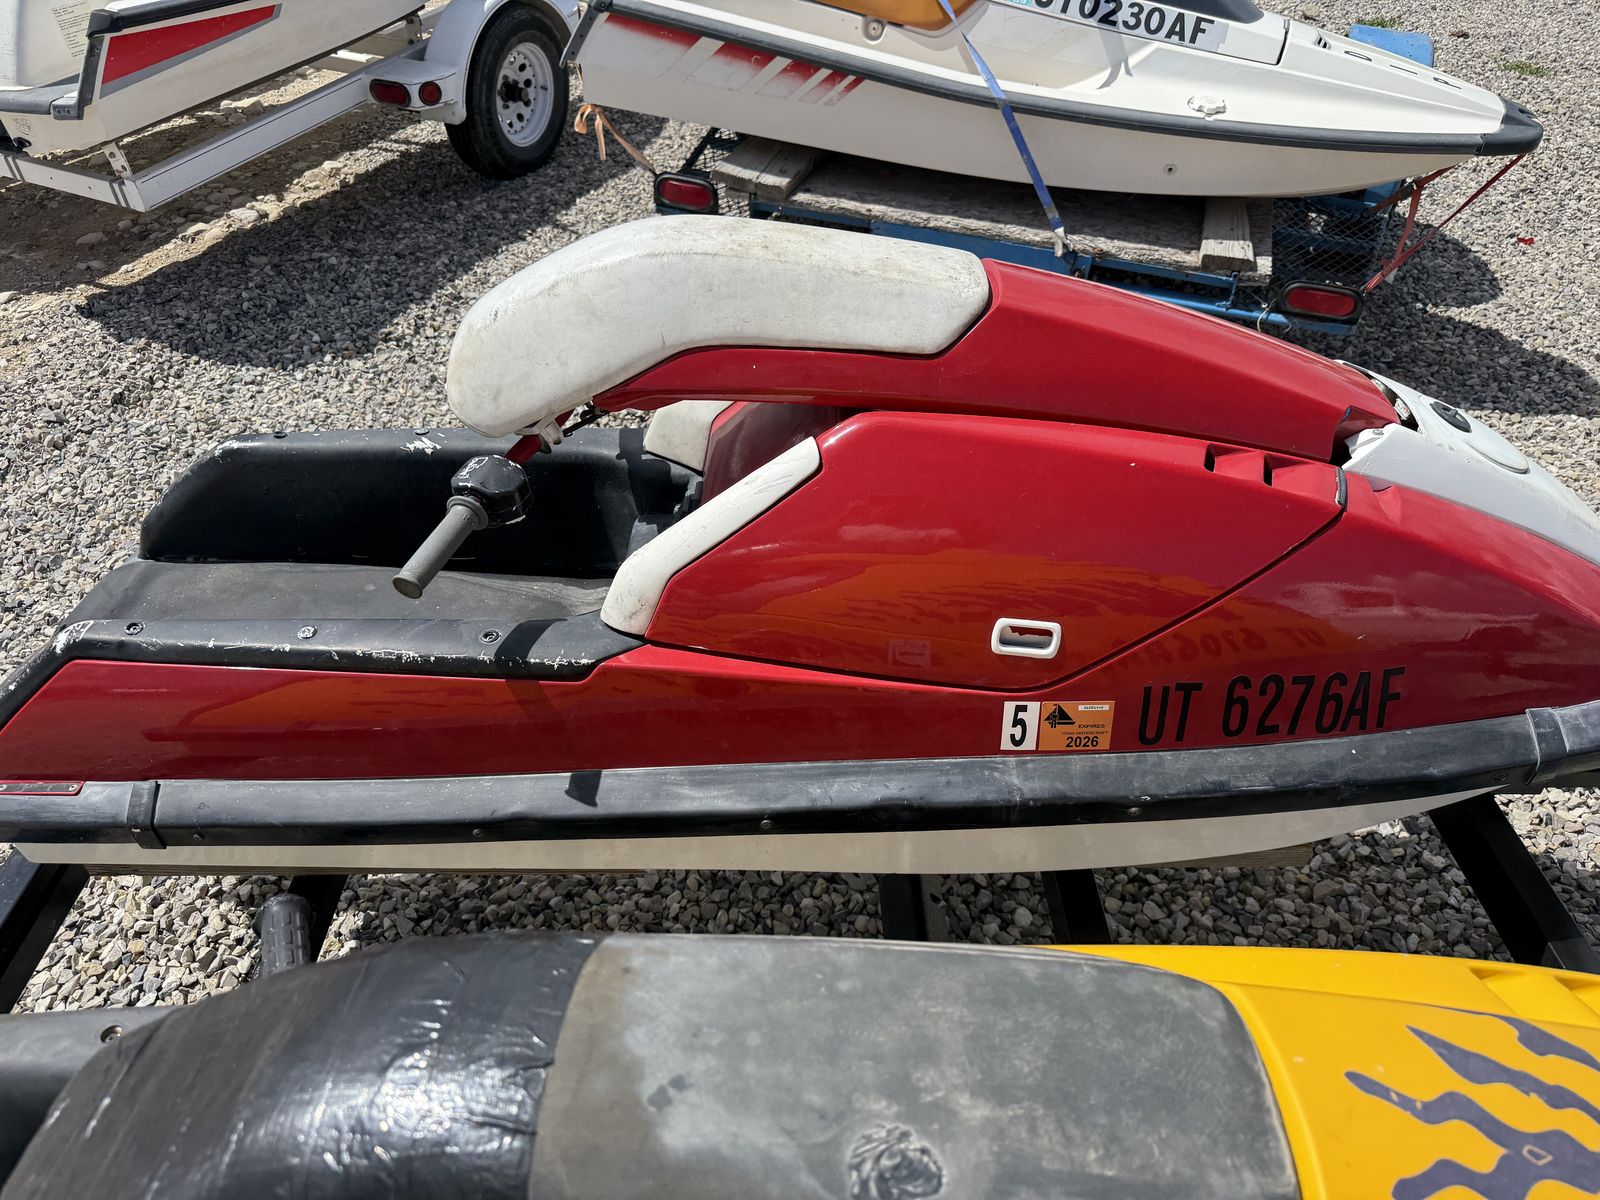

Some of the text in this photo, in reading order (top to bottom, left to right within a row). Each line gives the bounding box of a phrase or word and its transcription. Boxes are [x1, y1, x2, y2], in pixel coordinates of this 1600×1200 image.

[1010, 705, 1028, 747] 5
[1138, 666, 1406, 745] UT 6276AF
[1065, 736, 1099, 748] 2026
